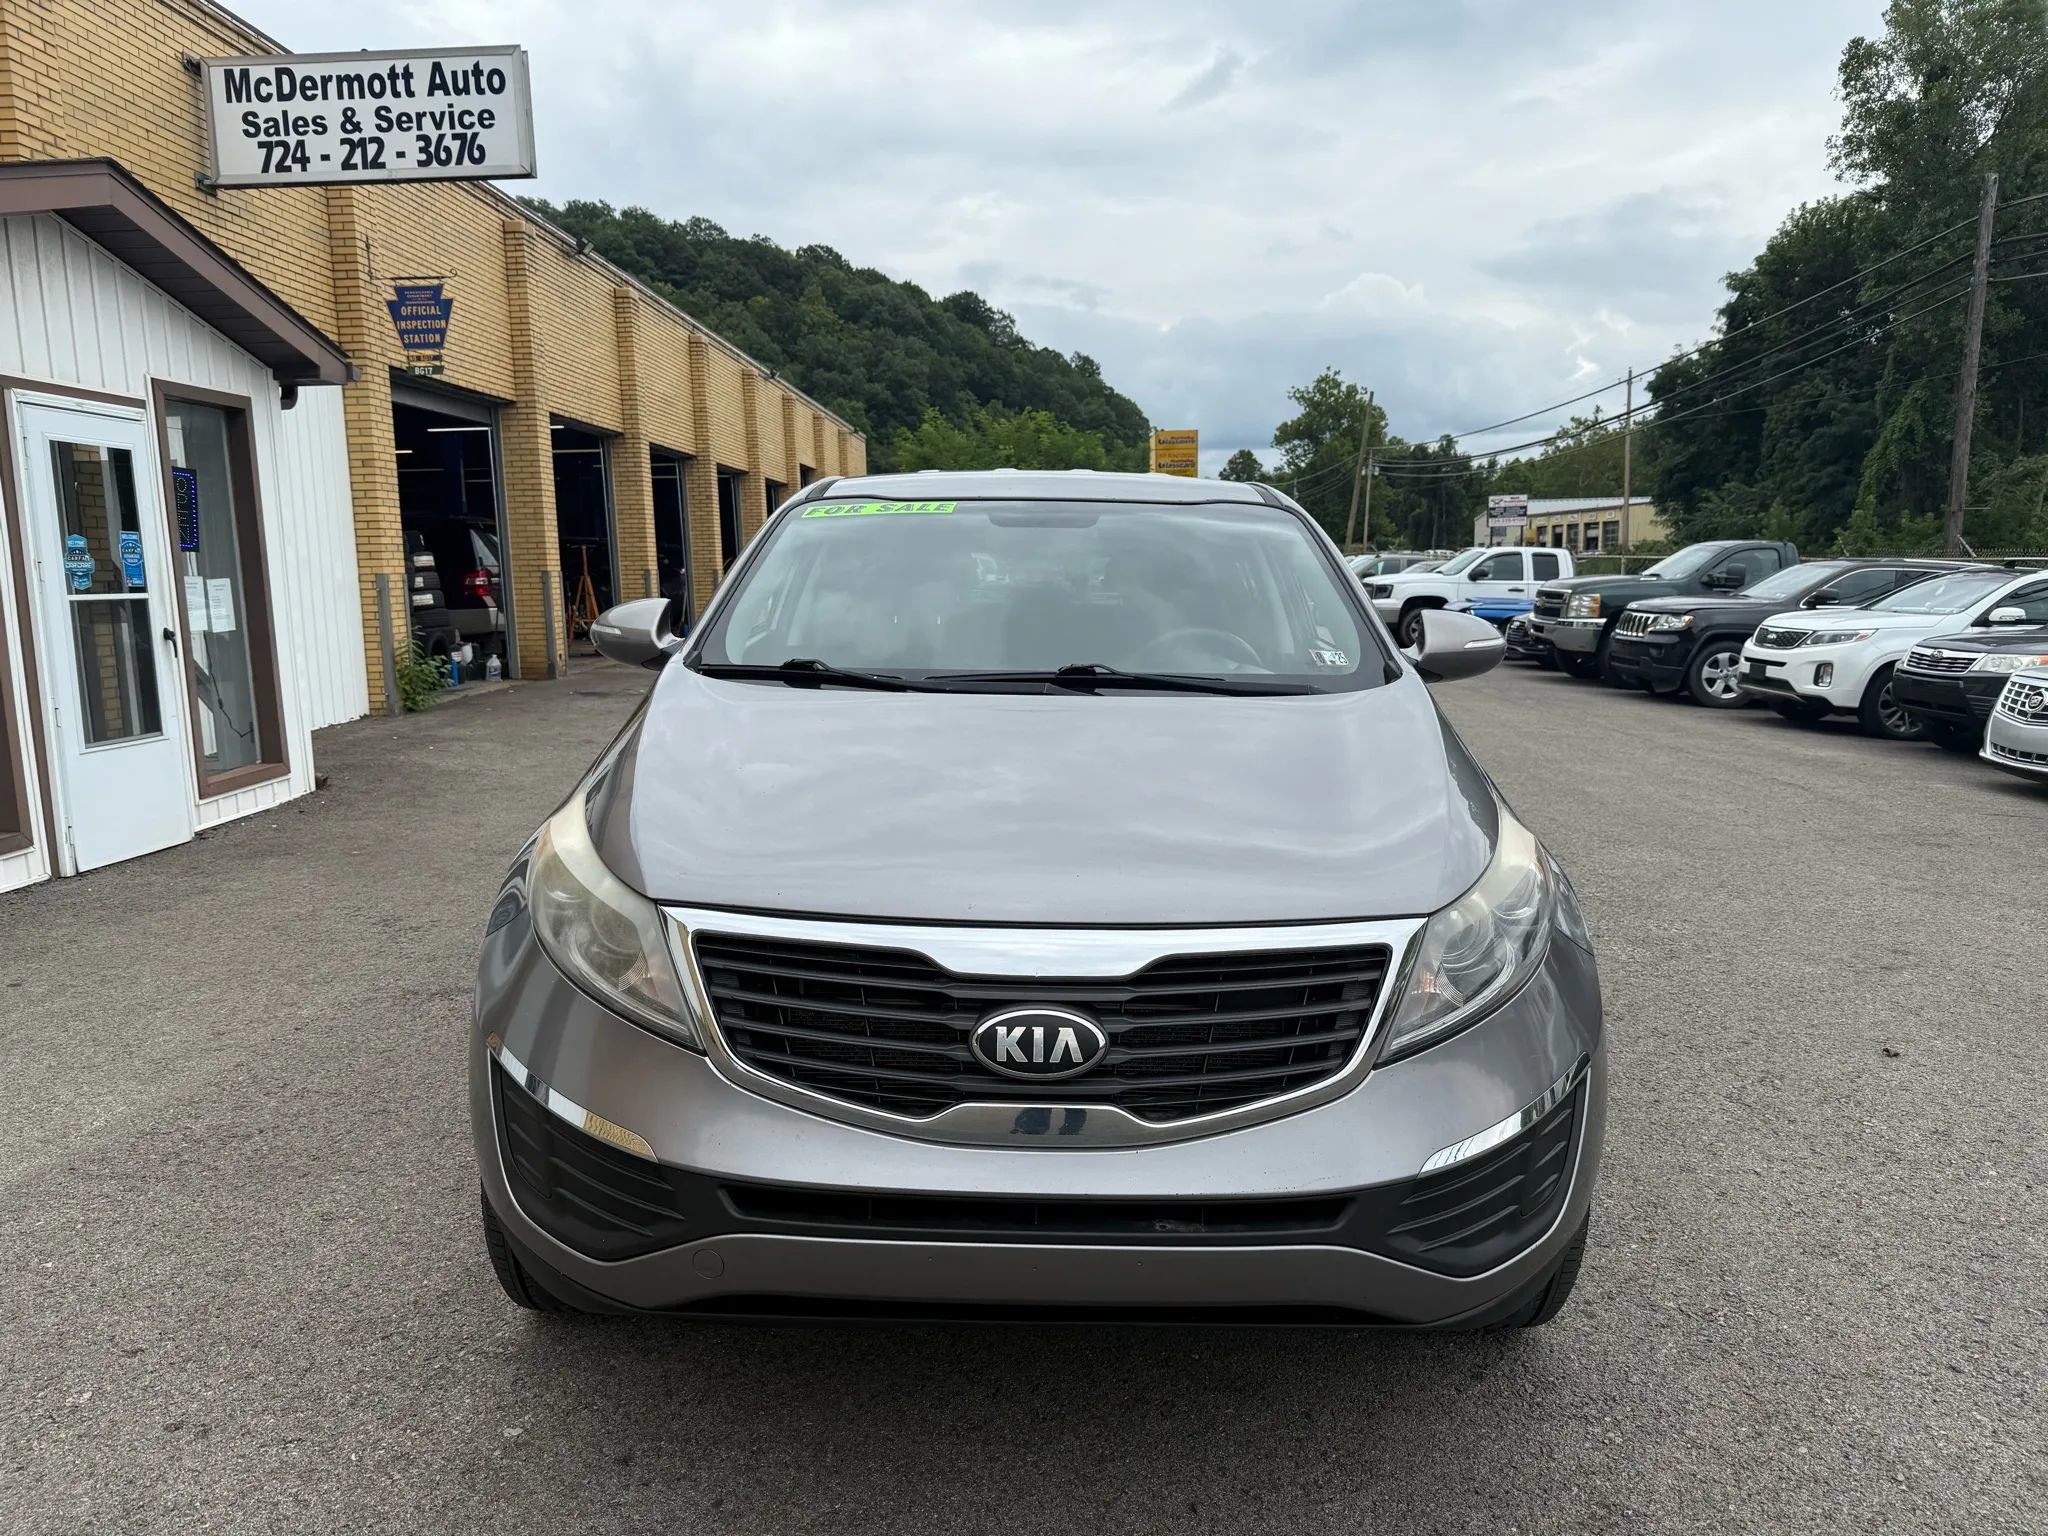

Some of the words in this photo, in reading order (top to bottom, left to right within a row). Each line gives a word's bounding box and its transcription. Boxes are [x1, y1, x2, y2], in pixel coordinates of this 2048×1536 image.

[223, 63, 416, 104] McDermott
[427, 60, 506, 97] Auto
[241, 109, 328, 138] Sales
[340, 106, 363, 135] &
[375, 103, 496, 134] Service
[257, 139, 311, 174] 724
[340, 136, 386, 171] 212
[416, 132, 486, 168] 3676
[397, 319, 446, 330] INSPECTION
[401, 305, 441, 316] OFFICIAL
[403, 334, 441, 344] STATION
[177, 478, 189, 543] OPEN
[804, 505, 867, 516] FOR
[876, 502, 954, 513] SALE
[995, 1026, 1084, 1063] KIA
